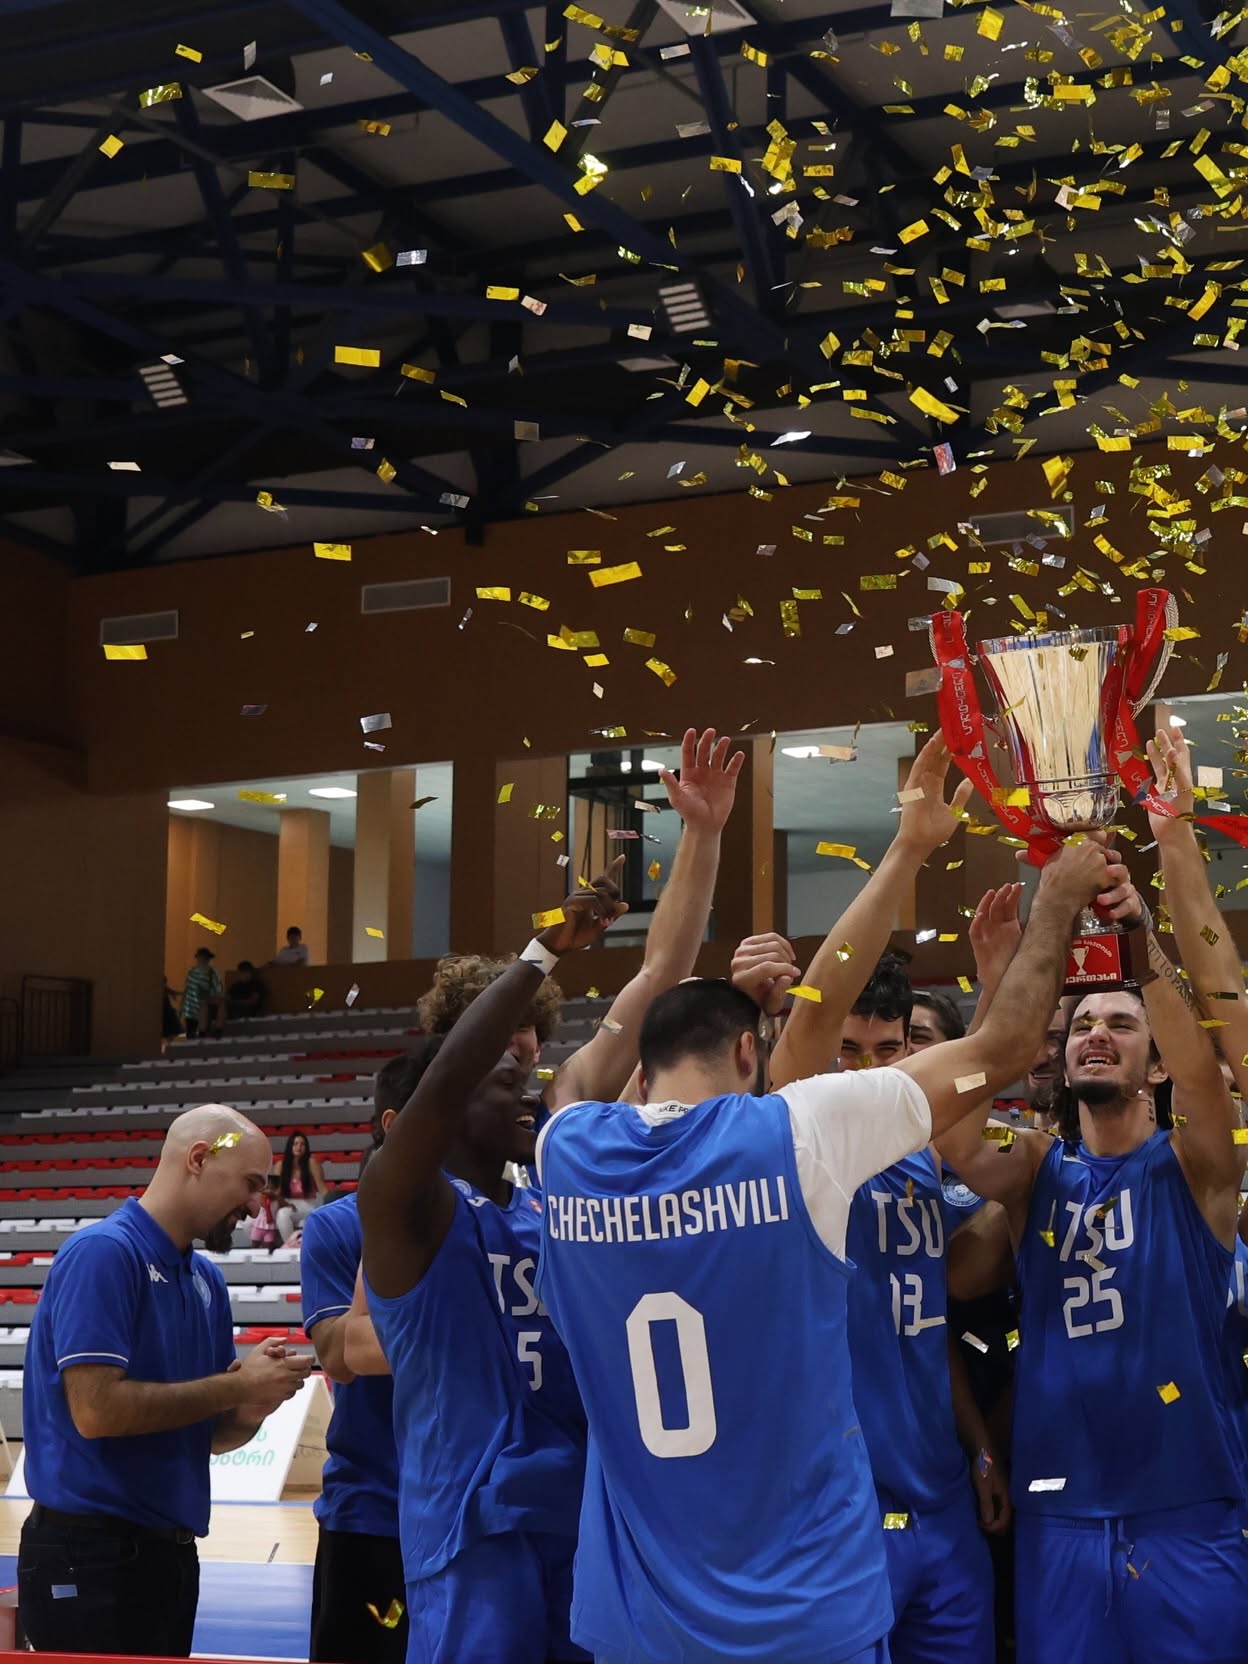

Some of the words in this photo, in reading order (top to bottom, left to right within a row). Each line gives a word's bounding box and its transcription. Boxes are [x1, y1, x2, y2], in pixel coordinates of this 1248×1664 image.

[548, 1175, 790, 1243] CHECHELASHVILI
[871, 1189, 945, 1258] TSU
[1059, 1188, 1134, 1262] TSU
[487, 1252, 550, 1317] TS
[889, 1272, 923, 1337] 13
[1062, 1266, 1125, 1339] 25
[516, 1331, 543, 1392] 5
[625, 1291, 717, 1458] 0
